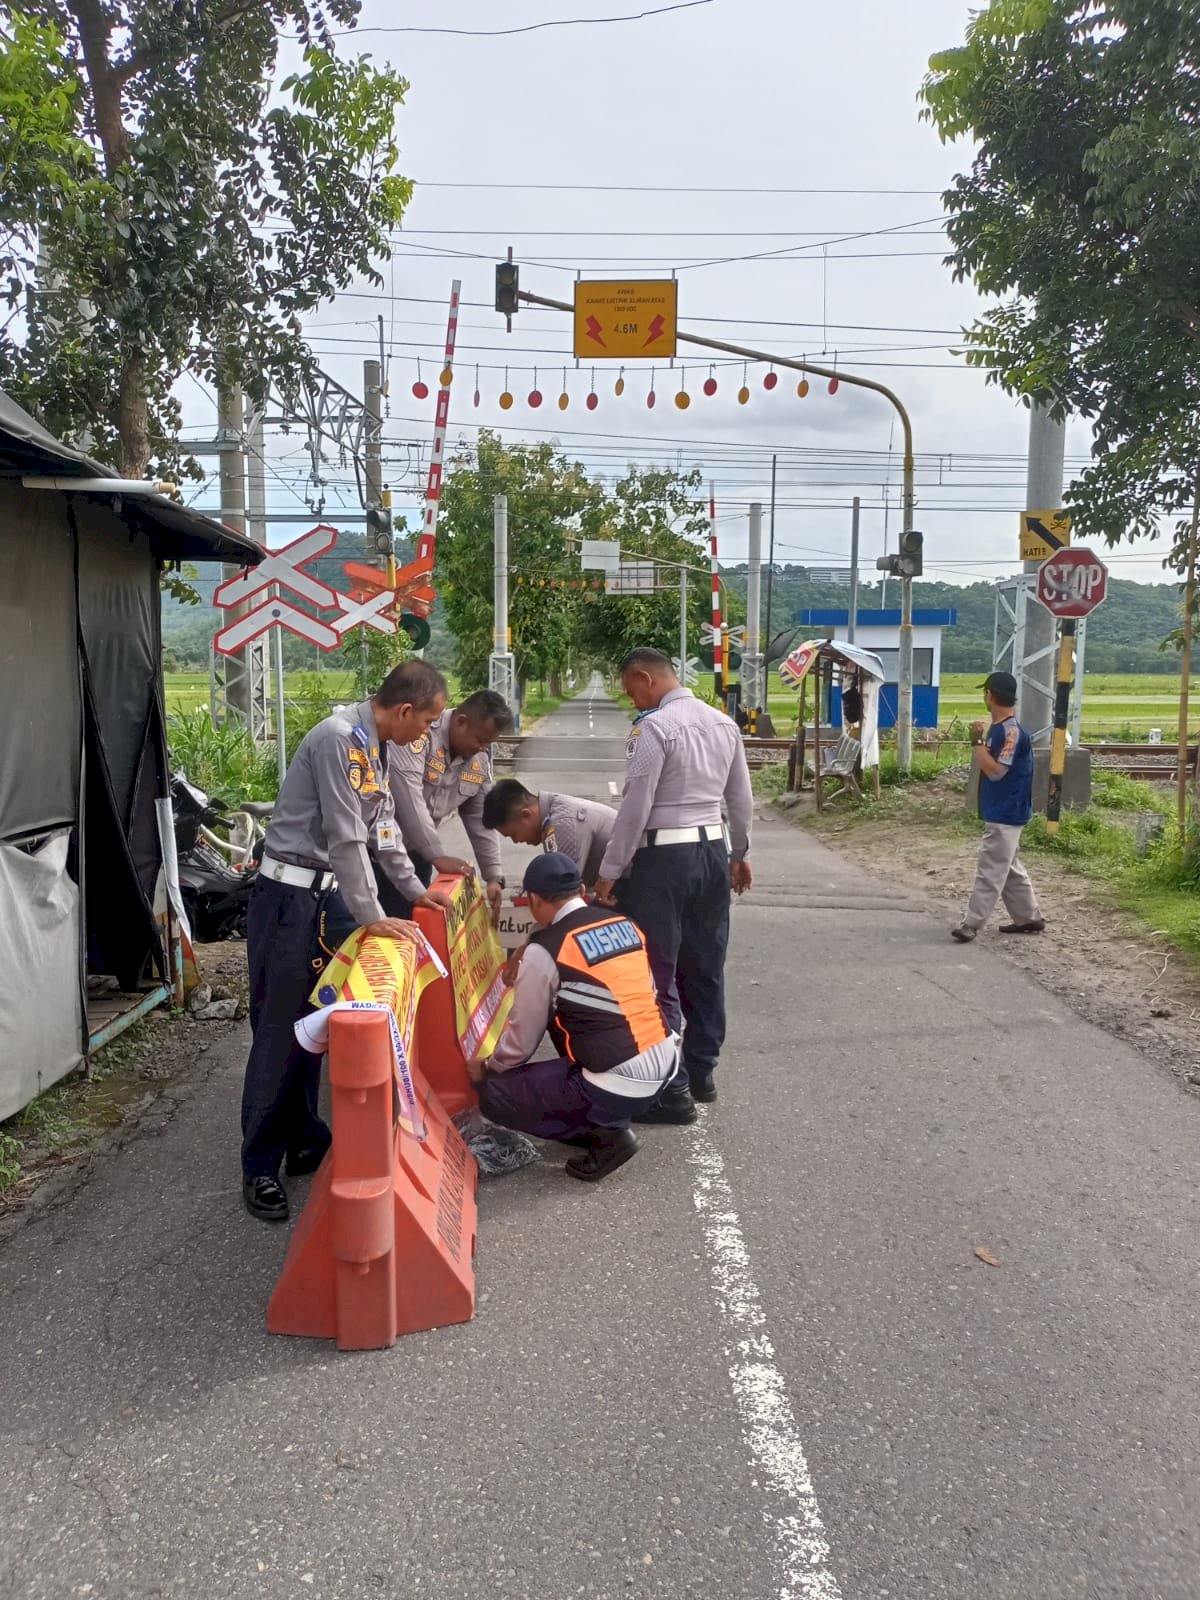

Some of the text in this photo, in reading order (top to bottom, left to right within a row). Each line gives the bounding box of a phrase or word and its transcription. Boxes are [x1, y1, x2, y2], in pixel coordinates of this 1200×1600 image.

[613, 324, 638, 334] 4.6M
[1043, 564, 1102, 600] STOP
[576, 921, 640, 960] DISHUB
